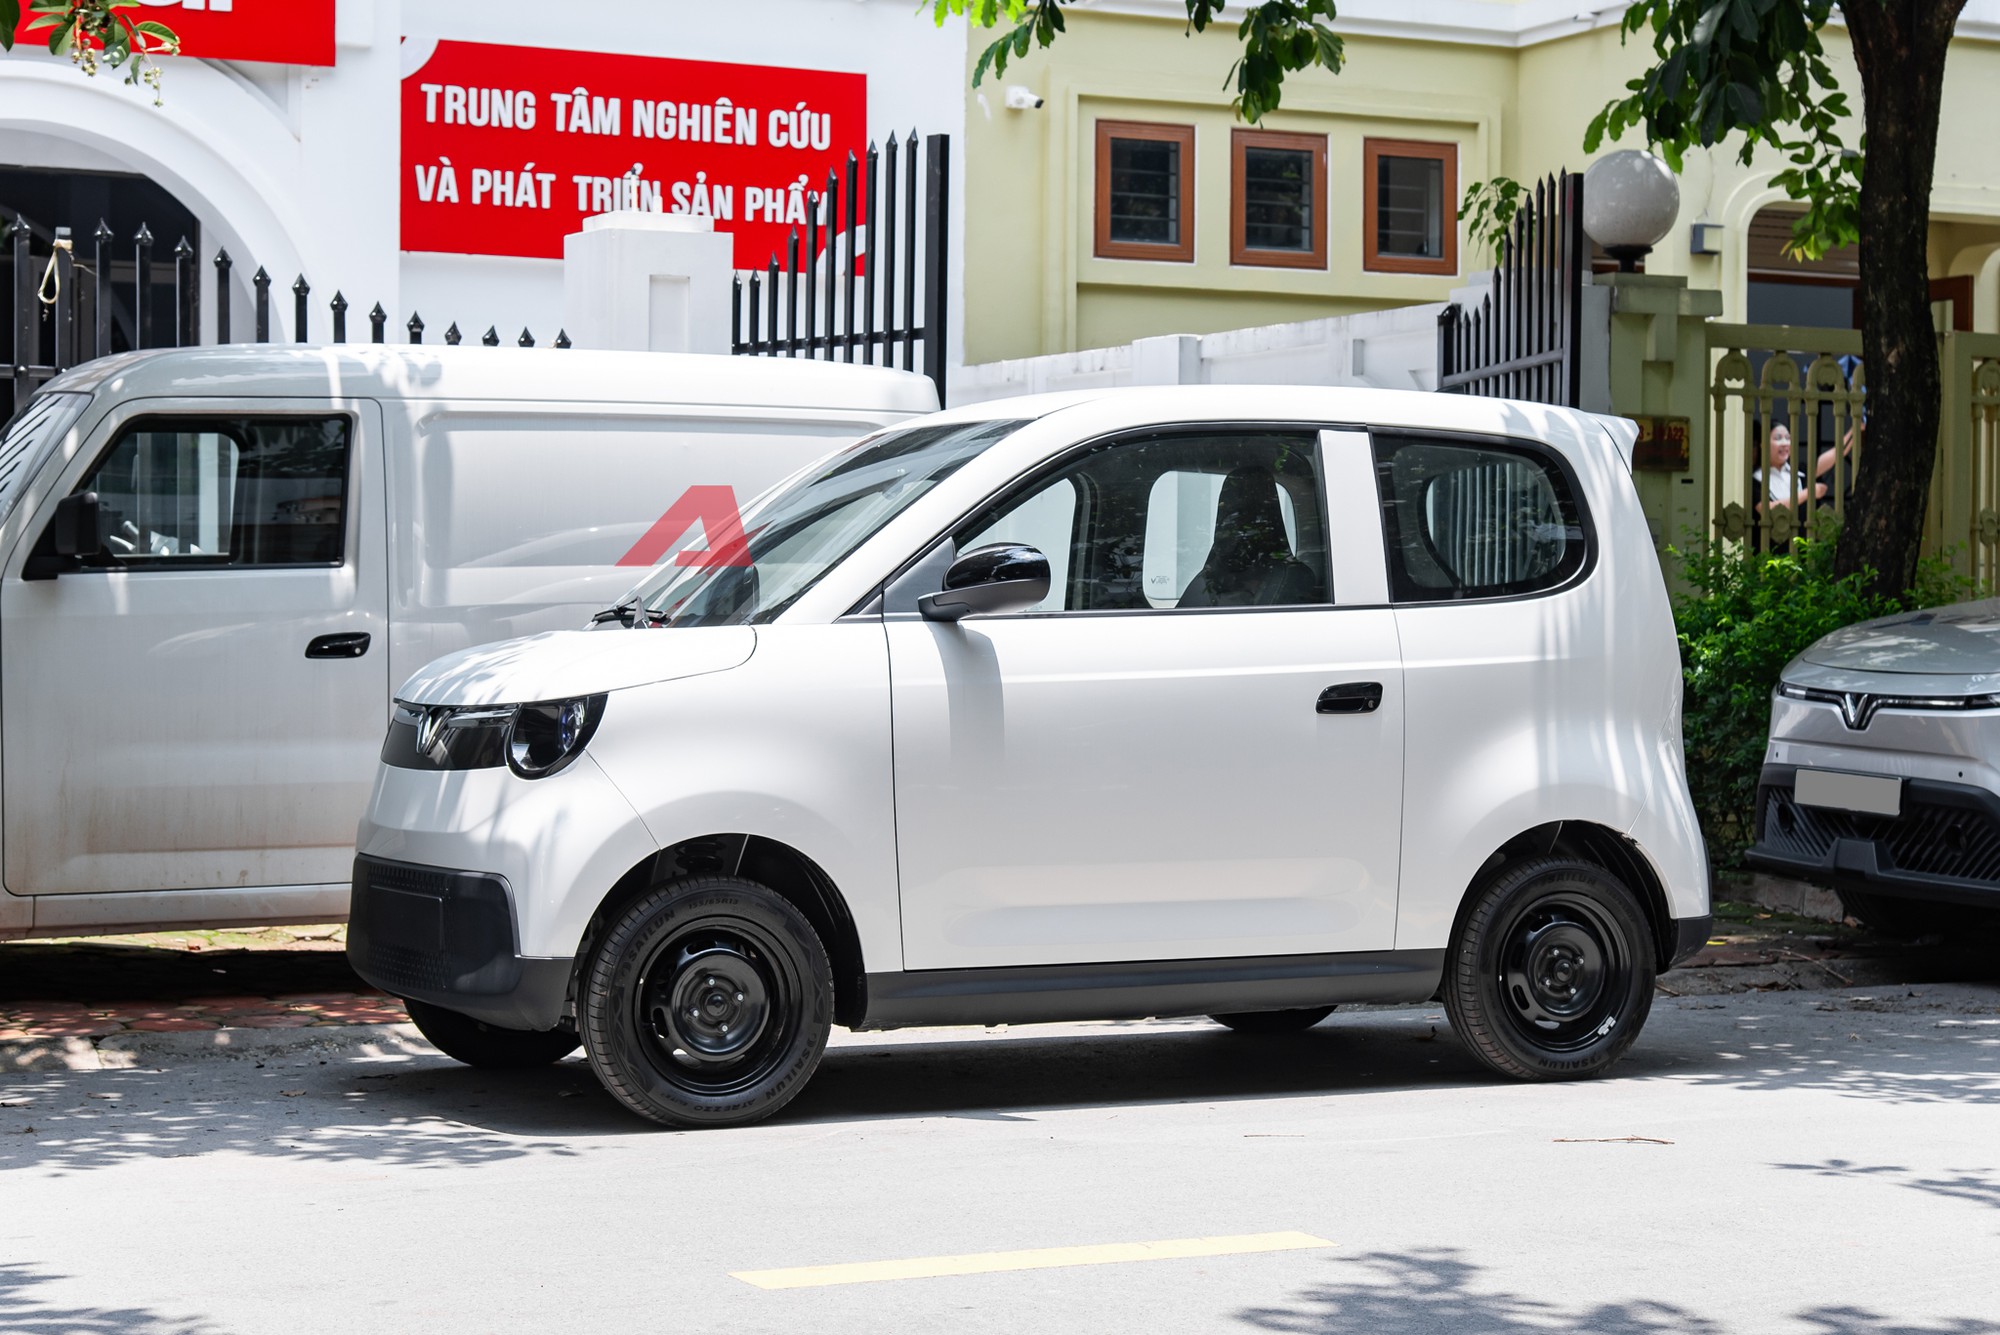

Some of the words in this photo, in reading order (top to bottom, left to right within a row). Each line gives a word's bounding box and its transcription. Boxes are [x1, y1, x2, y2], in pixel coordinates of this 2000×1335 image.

[420, 83, 536, 130] TRUNG
[550, 87, 621, 136] TÂM
[632, 97, 758, 146] NGHIÊN
[768, 101, 831, 151] CỨU
[415, 156, 459, 204] VÀ
[471, 162, 556, 209] PHÁT
[671, 171, 734, 220] SẢN
[628, 909, 677, 963] SAILUN
[765, 1047, 812, 1100] SAILUN
